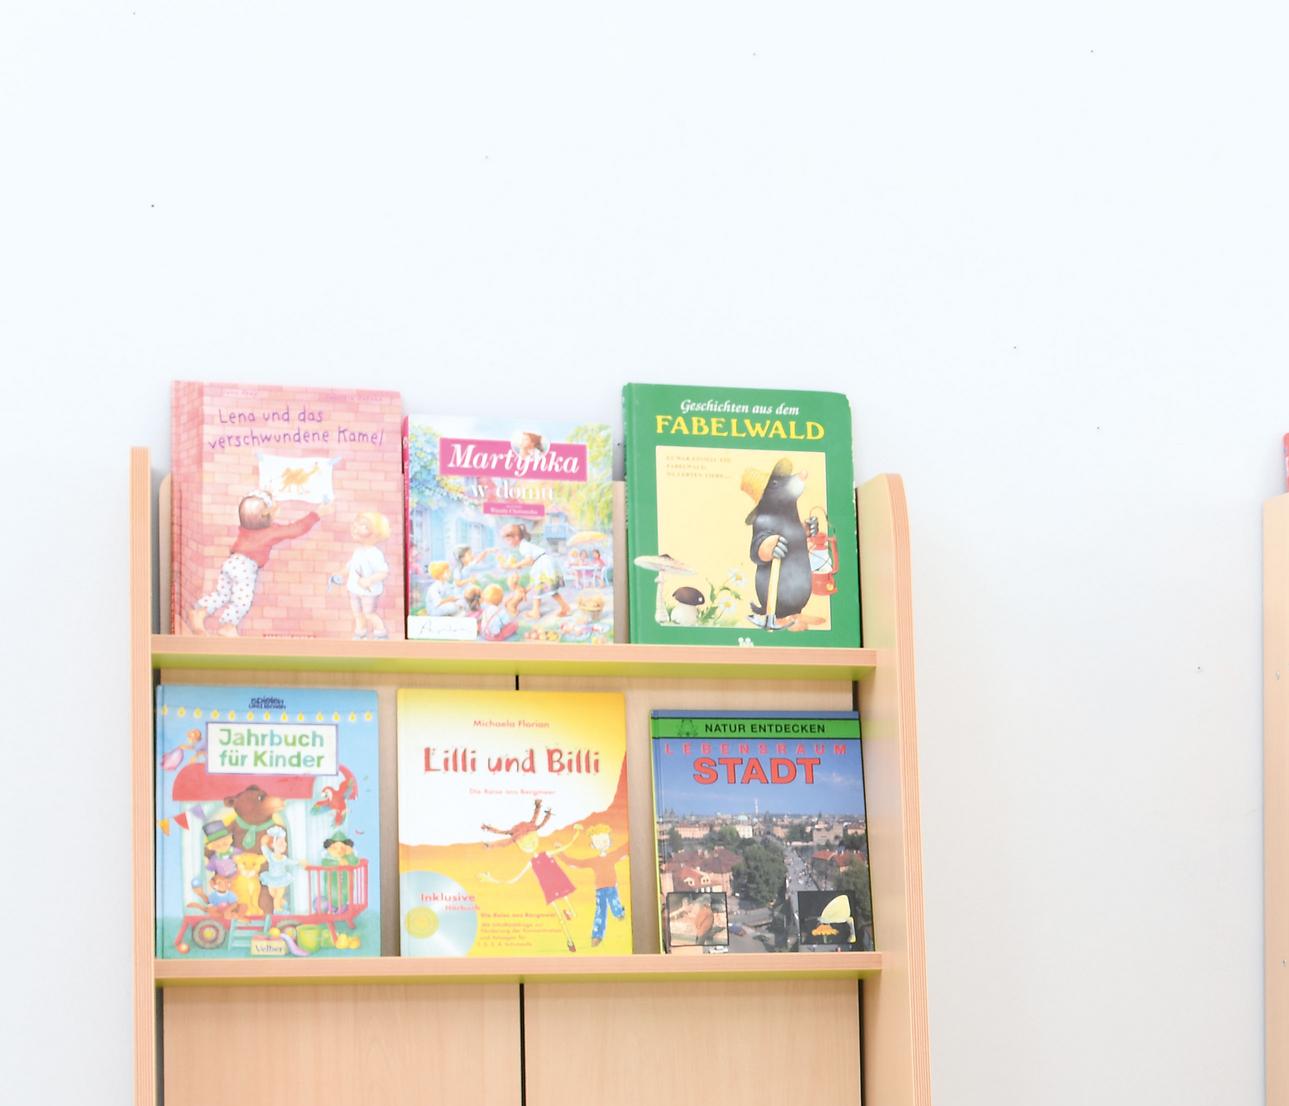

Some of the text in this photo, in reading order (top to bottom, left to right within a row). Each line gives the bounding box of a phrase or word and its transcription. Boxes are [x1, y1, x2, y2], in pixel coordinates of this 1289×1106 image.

[218, 406, 324, 424] Lena und das
[680, 399, 800, 416] Geschichten aus dem
[655, 414, 825, 440] FABELWALD
[208, 426, 385, 449] verschwundene Kamel
[448, 442, 580, 478] Martynka
[473, 719, 516, 729] Michaela
[704, 722, 826, 735] NATUR ENTDECKEN
[218, 727, 325, 748] Jahrbuch
[664, 741, 848, 756] LEBENSRAUM
[218, 749, 325, 769] für Kinder
[423, 746, 600, 774] Lilli und Billi
[692, 757, 822, 785] STADT
[420, 892, 477, 903] Inklusive
